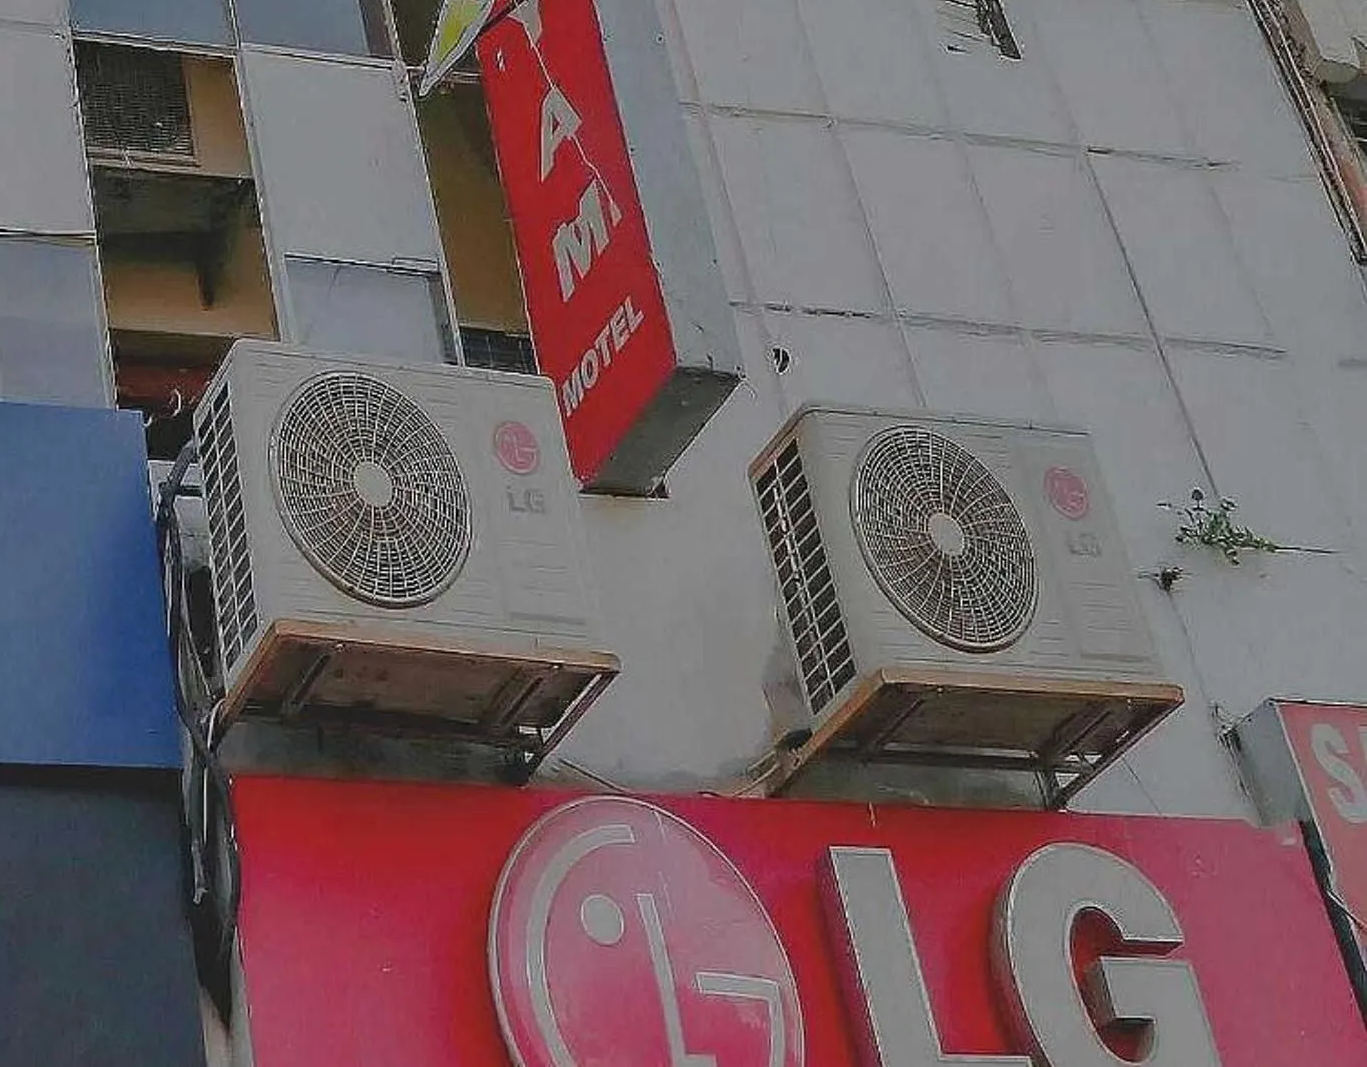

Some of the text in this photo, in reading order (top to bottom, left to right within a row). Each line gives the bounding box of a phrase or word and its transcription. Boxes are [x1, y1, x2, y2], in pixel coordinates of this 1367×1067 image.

[562, 295, 645, 417] MOTEL
[506, 489, 545, 514] LG
[823, 842, 1224, 1067] LG
